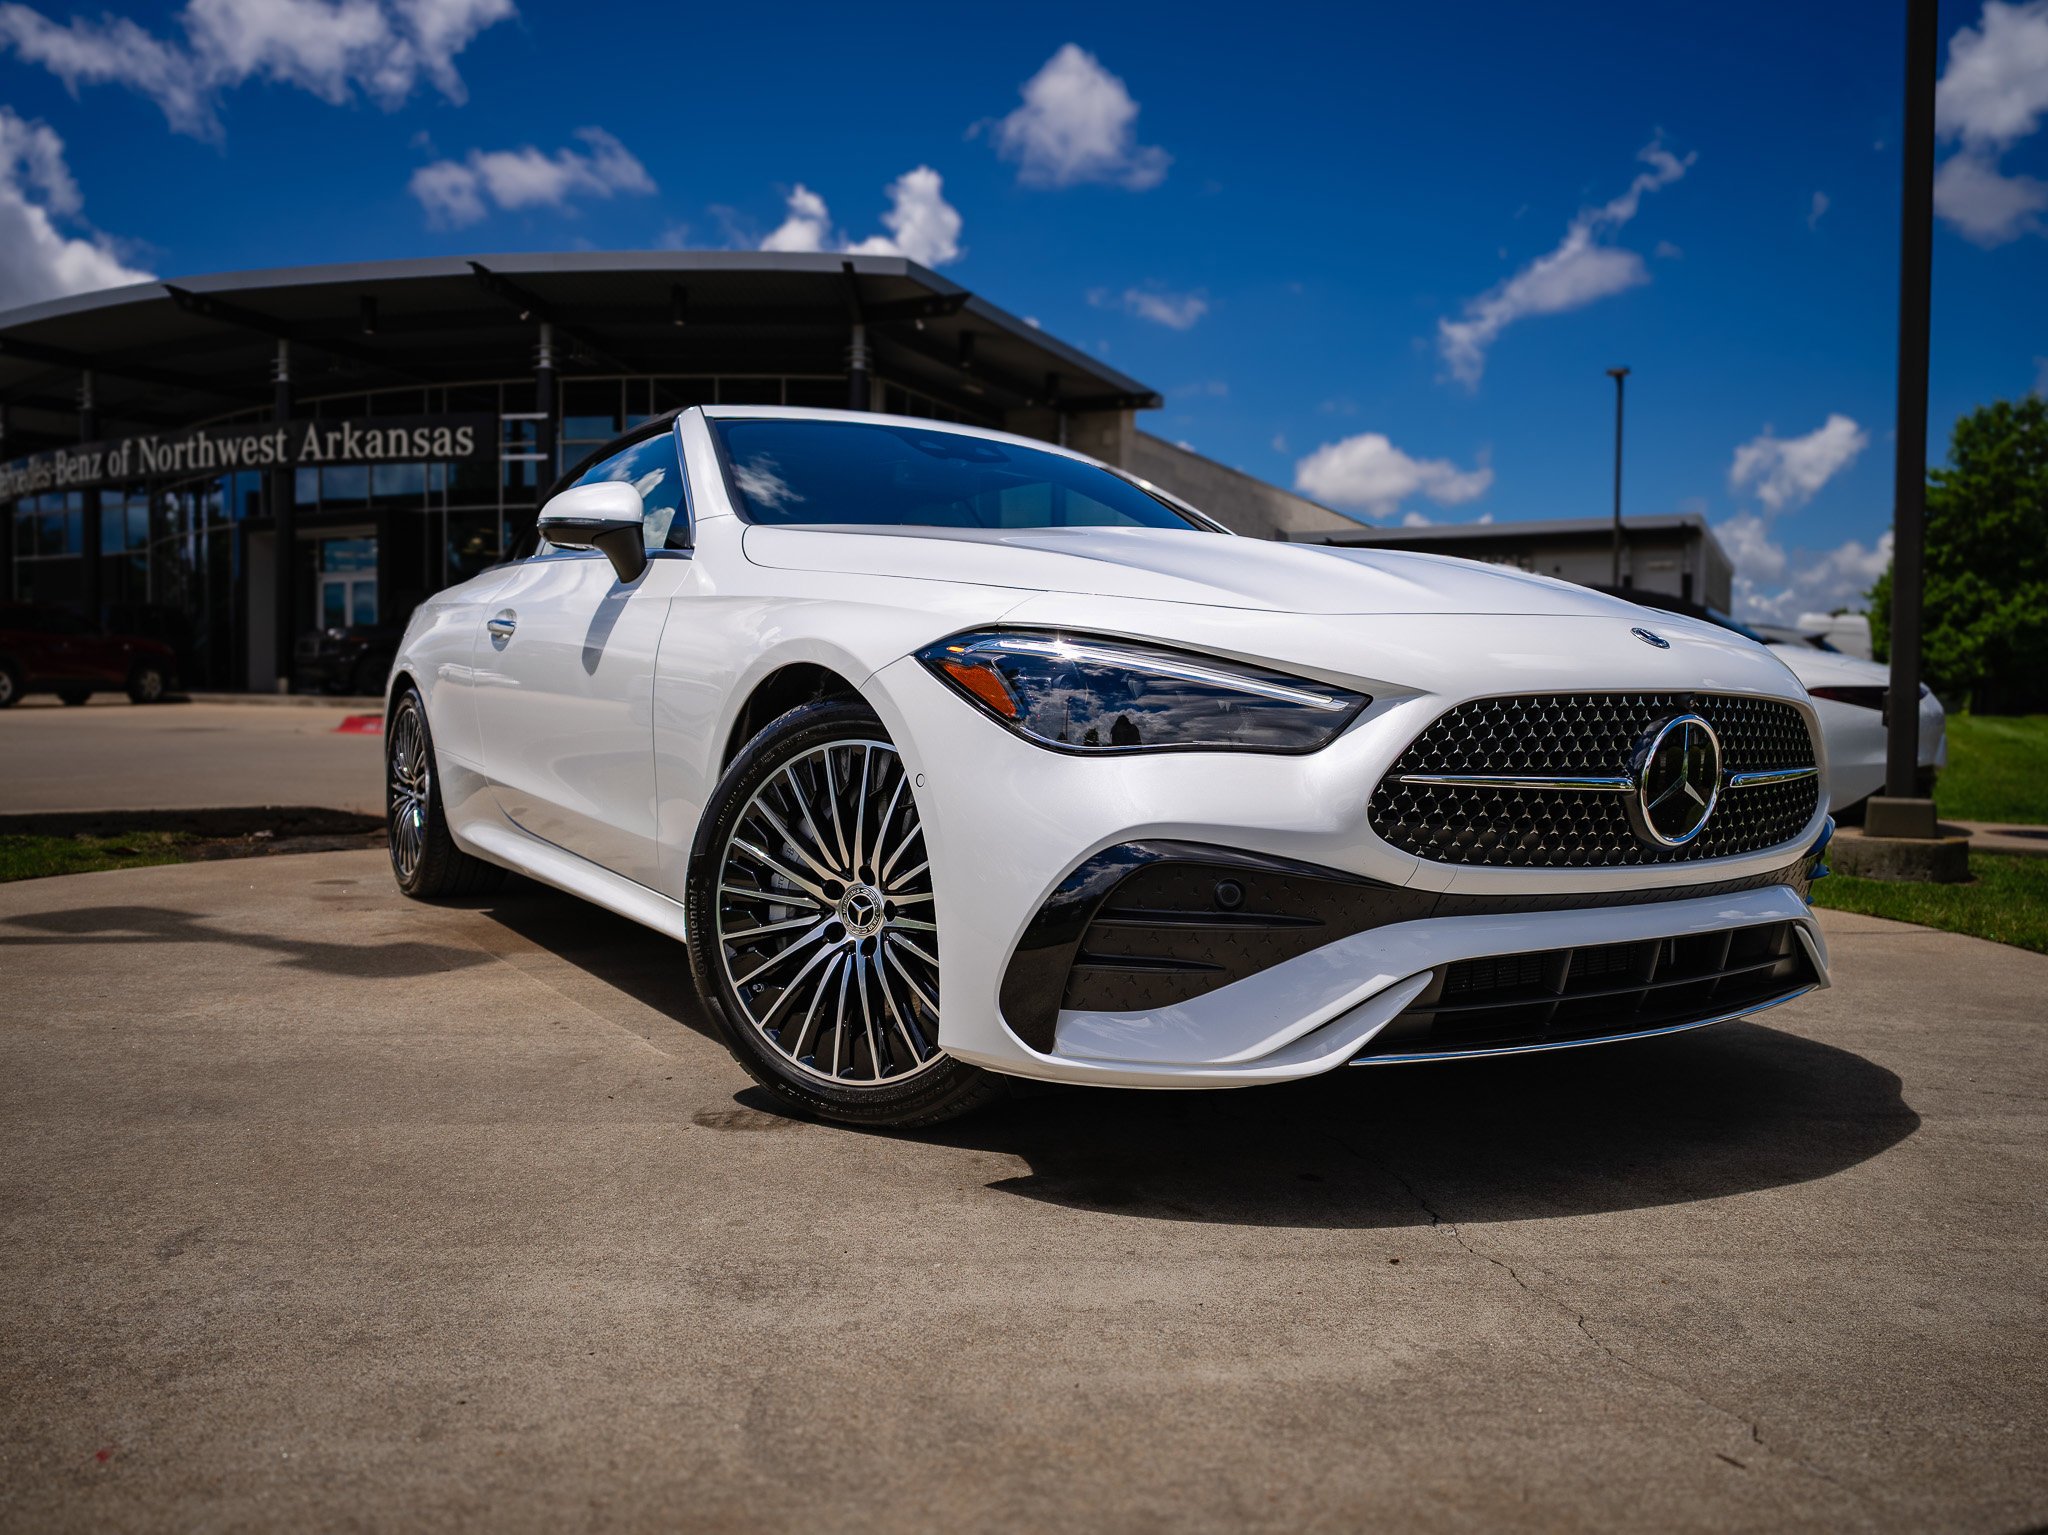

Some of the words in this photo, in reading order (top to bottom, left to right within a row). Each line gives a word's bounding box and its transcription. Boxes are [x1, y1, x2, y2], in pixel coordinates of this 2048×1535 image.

[107, 438, 131, 477] of
[138, 427, 287, 474] Northwest
[298, 421, 474, 462] Arkansas
[688, 889, 708, 977] Continental
